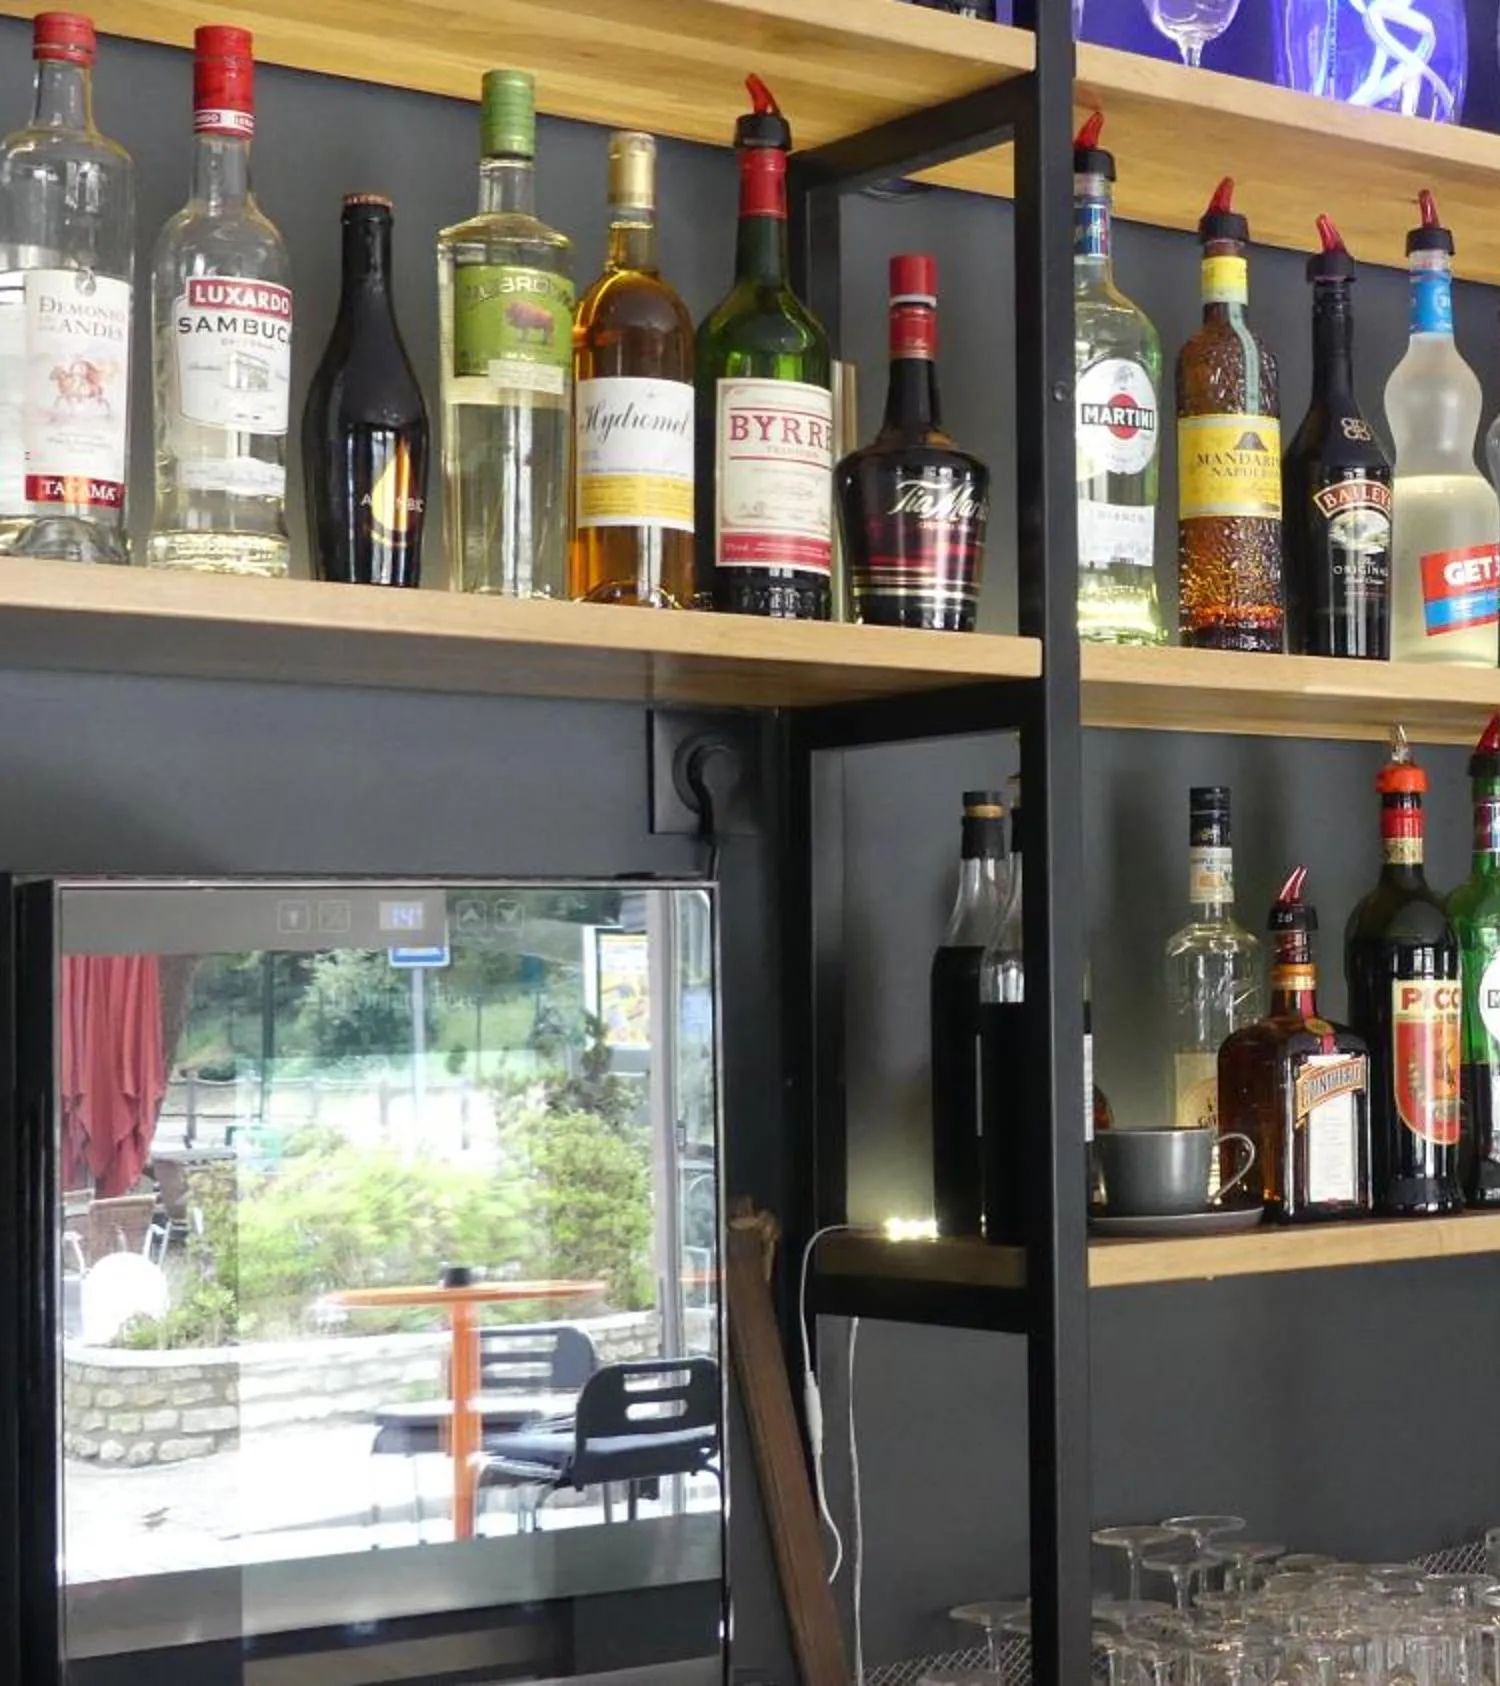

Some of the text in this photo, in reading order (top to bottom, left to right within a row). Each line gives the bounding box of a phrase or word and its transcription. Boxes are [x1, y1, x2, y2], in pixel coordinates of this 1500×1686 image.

[194, 284, 290, 315] LUXARDO
[178, 315, 289, 343] SAMBUC
[1082, 405, 1154, 430] MARTINI
[1443, 560, 1492, 586] GET
